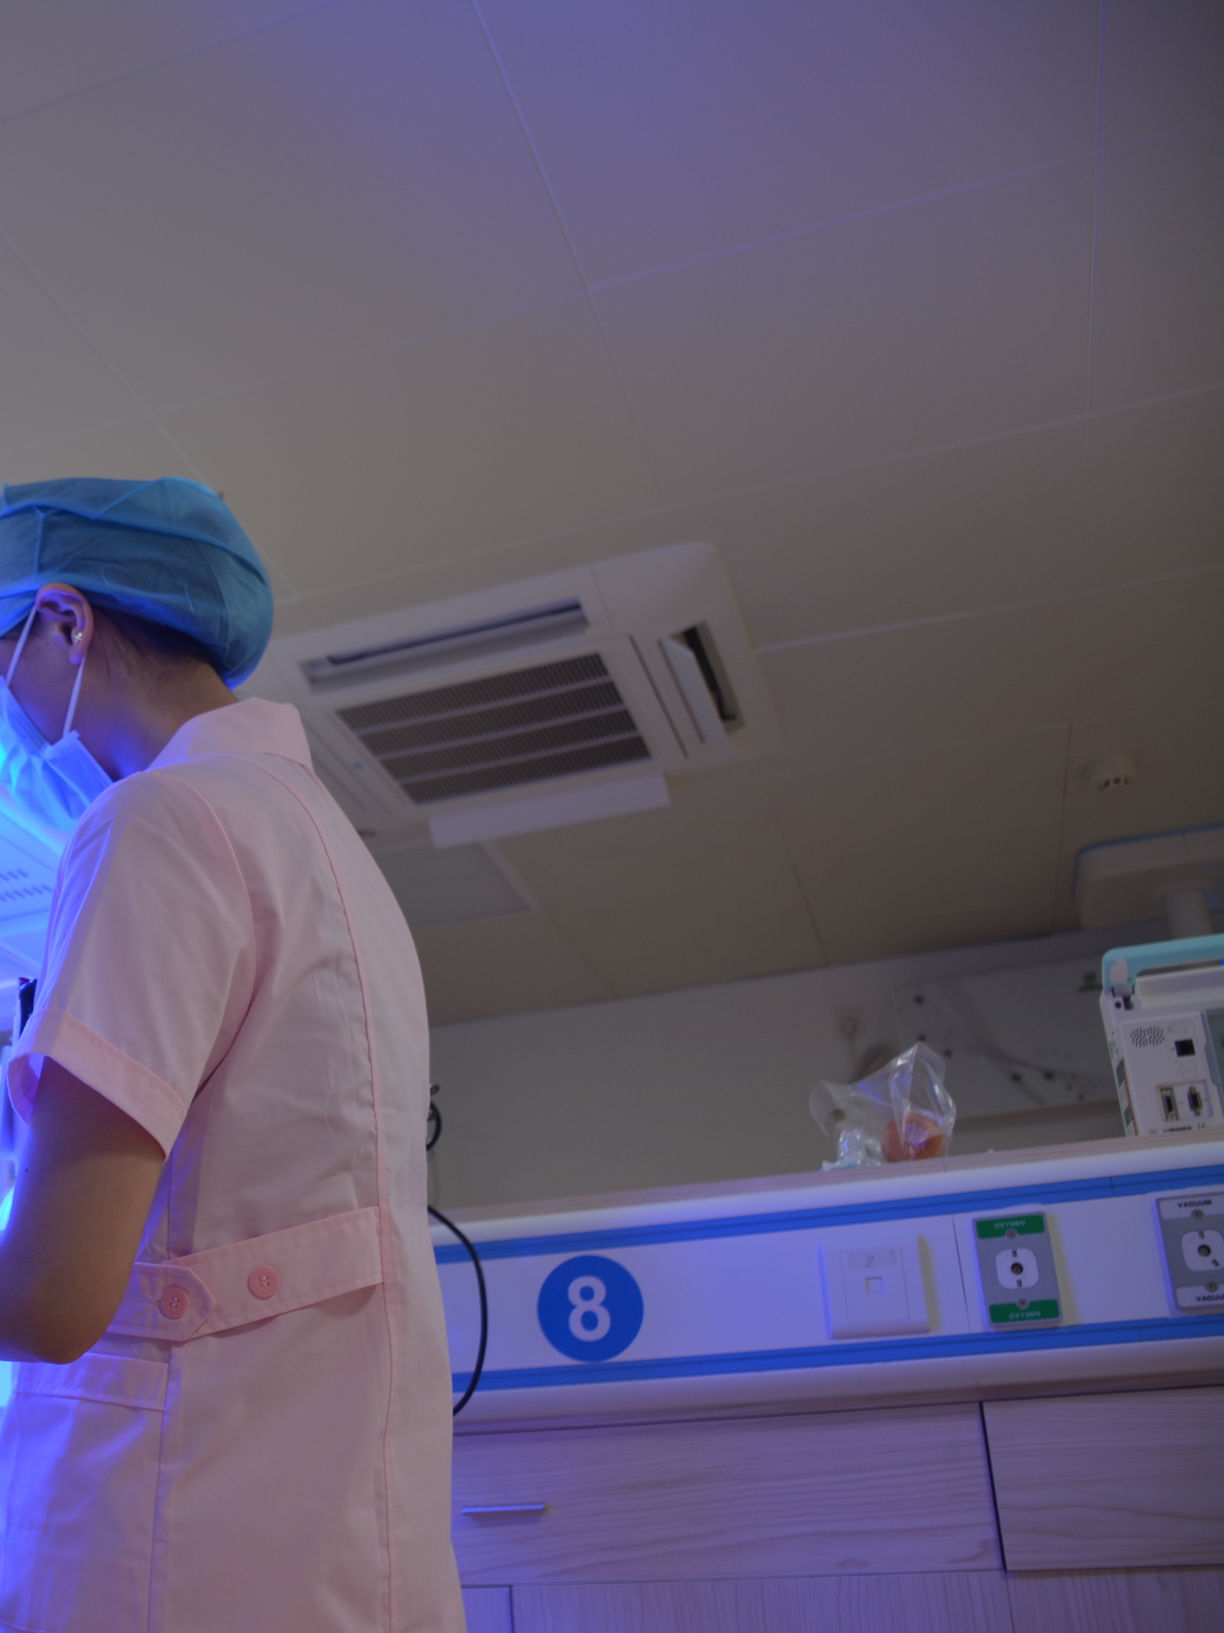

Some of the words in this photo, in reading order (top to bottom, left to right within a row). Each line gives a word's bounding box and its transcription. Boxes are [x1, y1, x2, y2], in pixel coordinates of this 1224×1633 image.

[1177, 1199, 1212, 1209] VACUUM
[1195, 1294, 1224, 1303] VACUU
[567, 1275, 611, 1342] 8
